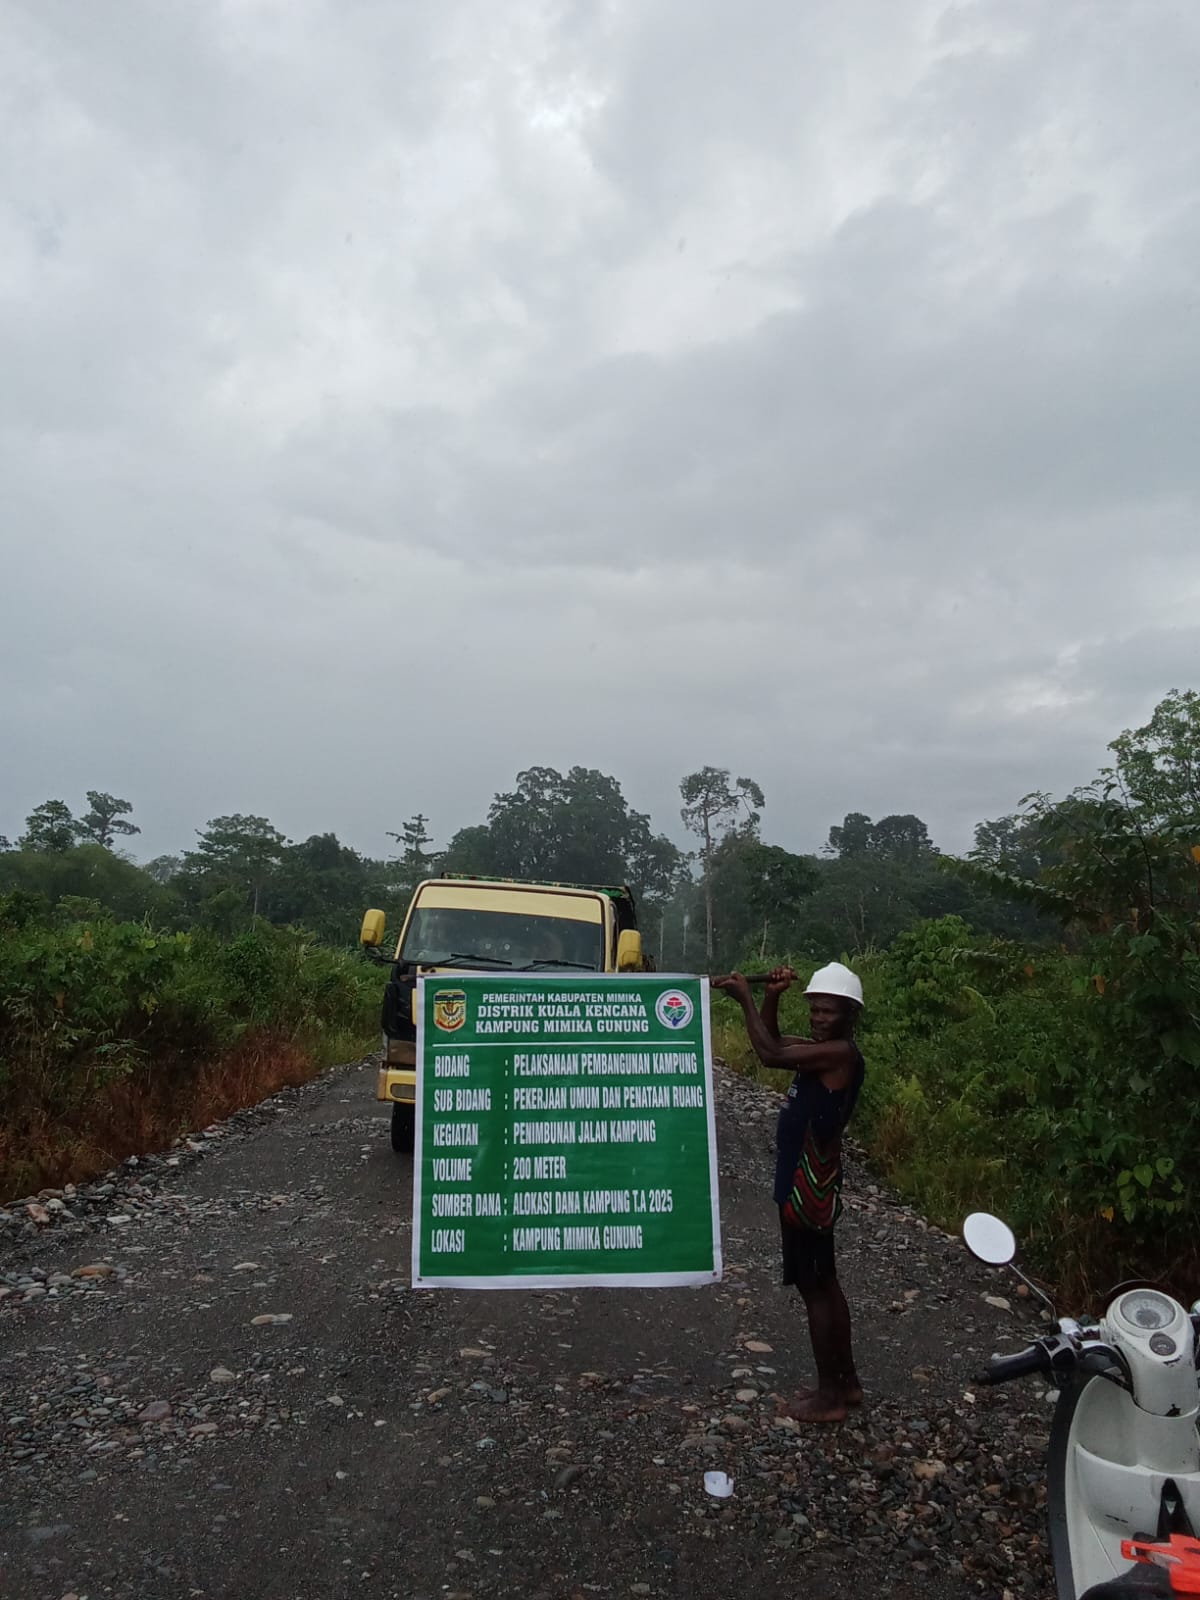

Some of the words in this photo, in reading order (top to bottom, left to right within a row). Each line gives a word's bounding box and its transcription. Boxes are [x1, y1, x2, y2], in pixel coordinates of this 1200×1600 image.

[483, 993, 544, 1002] PEMERINTAH
[547, 993, 605, 1002] KABUPATEN
[607, 993, 641, 1002] MIMIKA
[478, 1006, 534, 1017] DISTRIK
[538, 1006, 581, 1017] KUALA
[585, 1005, 646, 1017] KENCANA
[476, 1021, 539, 1033] KAMPUNG
[544, 1021, 592, 1032] MIMIKA
[597, 1020, 649, 1033] GUNUNG
[435, 1055, 470, 1077] BIDANG
[514, 1054, 578, 1075] PELAKSANAAN
[581, 1053, 650, 1075] PEMBANGUNAN
[653, 1052, 697, 1074] KAMPUNG
[434, 1089, 453, 1112] SUB
[456, 1089, 491, 1111] BIDANG
[514, 1088, 567, 1110] PEKERJAAN
[570, 1087, 600, 1109] UMUM
[603, 1087, 621, 1108] DAN
[624, 1086, 670, 1108] PENATAAN
[673, 1085, 703, 1108] RUANG
[434, 1123, 479, 1146] KEGIATAN
[513, 1121, 576, 1144] PENIMBUNAN
[578, 1121, 607, 1143] JALAN
[610, 1120, 656, 1142] KAMPUNG
[433, 1158, 472, 1181] VOLUME
[513, 1157, 531, 1180] 200
[534, 1156, 566, 1179] METER
[432, 1194, 473, 1216] SUMBER
[476, 1193, 501, 1216] DANA
[513, 1192, 552, 1215] ALOKASI
[555, 1191, 580, 1214] DANA
[583, 1190, 630, 1214] KAMPUNG
[632, 1190, 646, 1212] T.A
[649, 1189, 673, 1212] 2025
[432, 1229, 465, 1252] LOKASI
[513, 1227, 560, 1251] KAMPUNG
[564, 1227, 600, 1250] MIMIKA
[603, 1225, 642, 1249] GUNUNG
